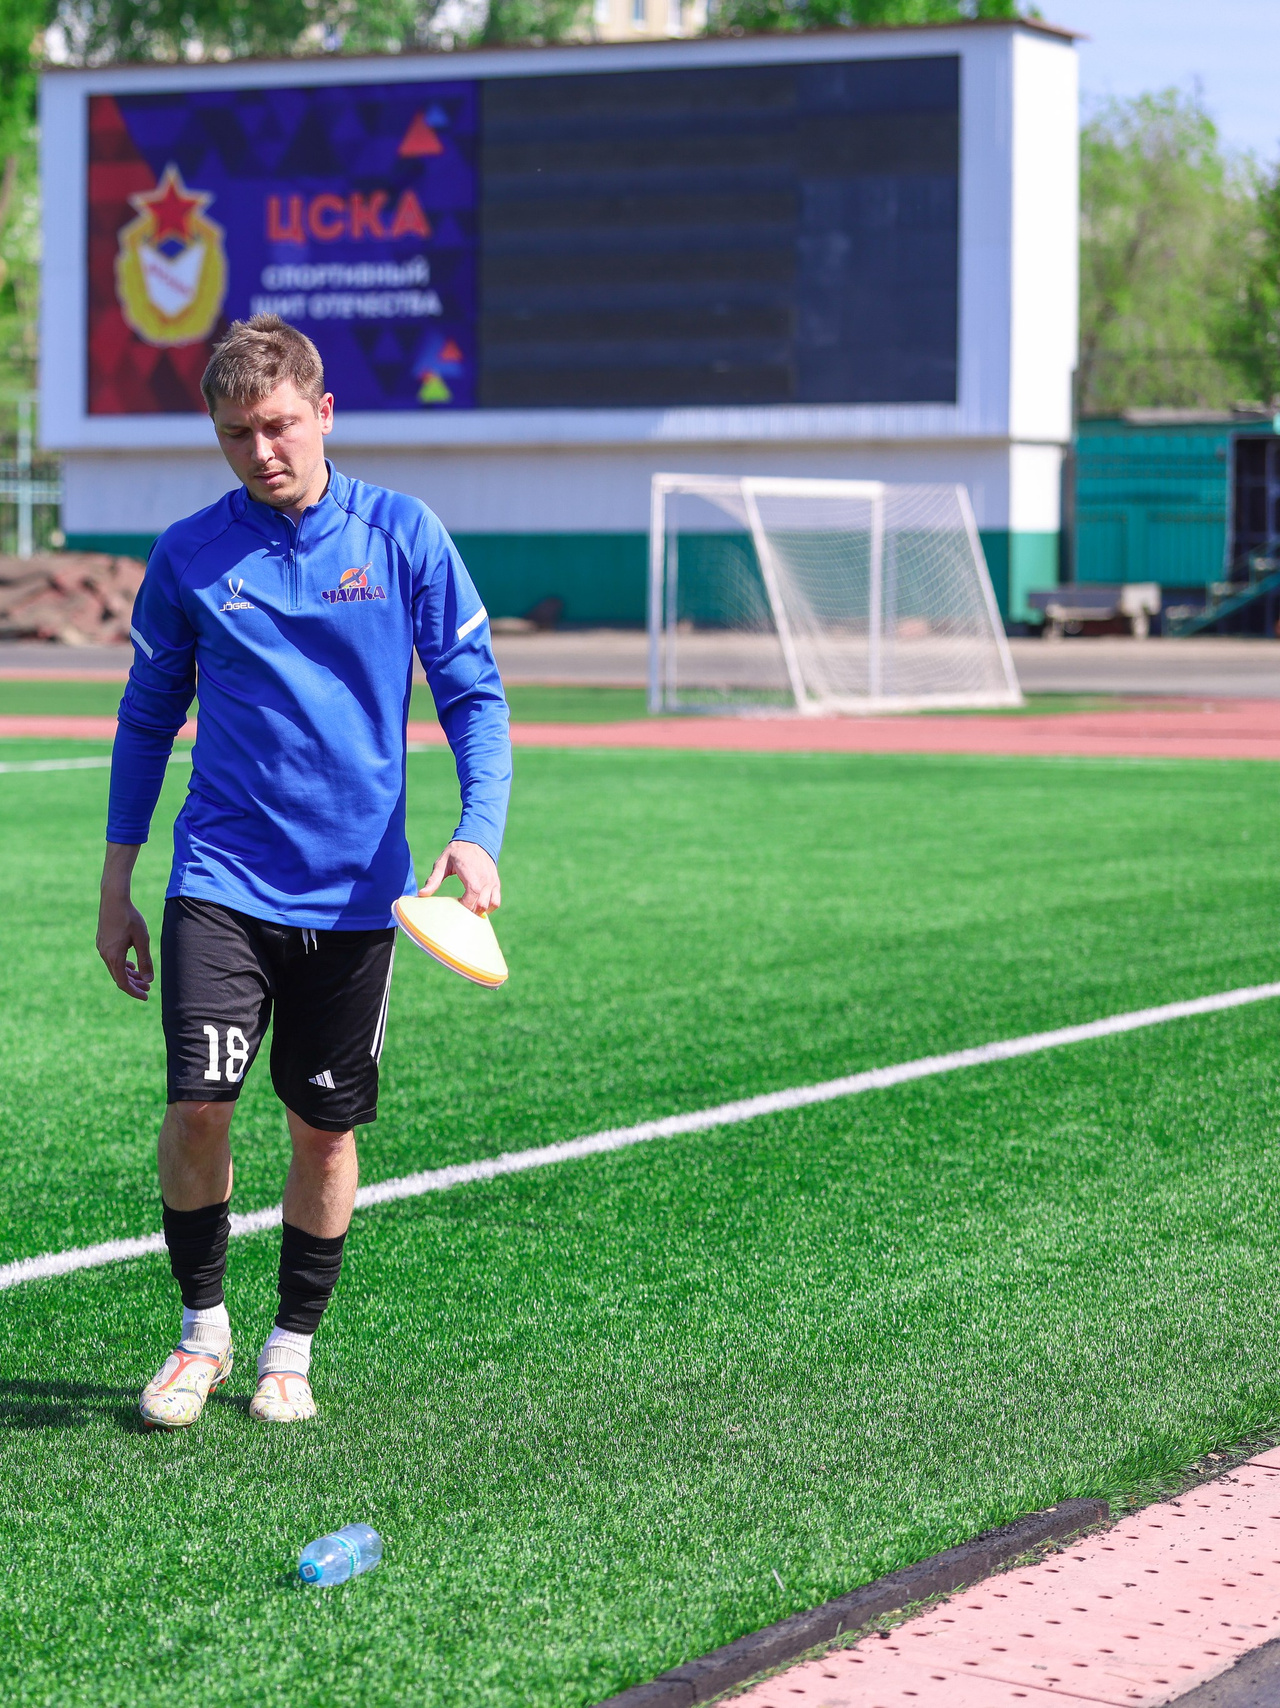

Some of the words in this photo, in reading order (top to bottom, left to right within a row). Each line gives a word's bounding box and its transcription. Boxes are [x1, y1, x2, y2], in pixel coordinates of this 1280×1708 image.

[267, 189, 431, 243] ЦСКА
[262, 255, 429, 289] СПОРТИВНЫЙ
[219, 601, 255, 612] JÖGEL
[203, 1025, 249, 1082] 18
